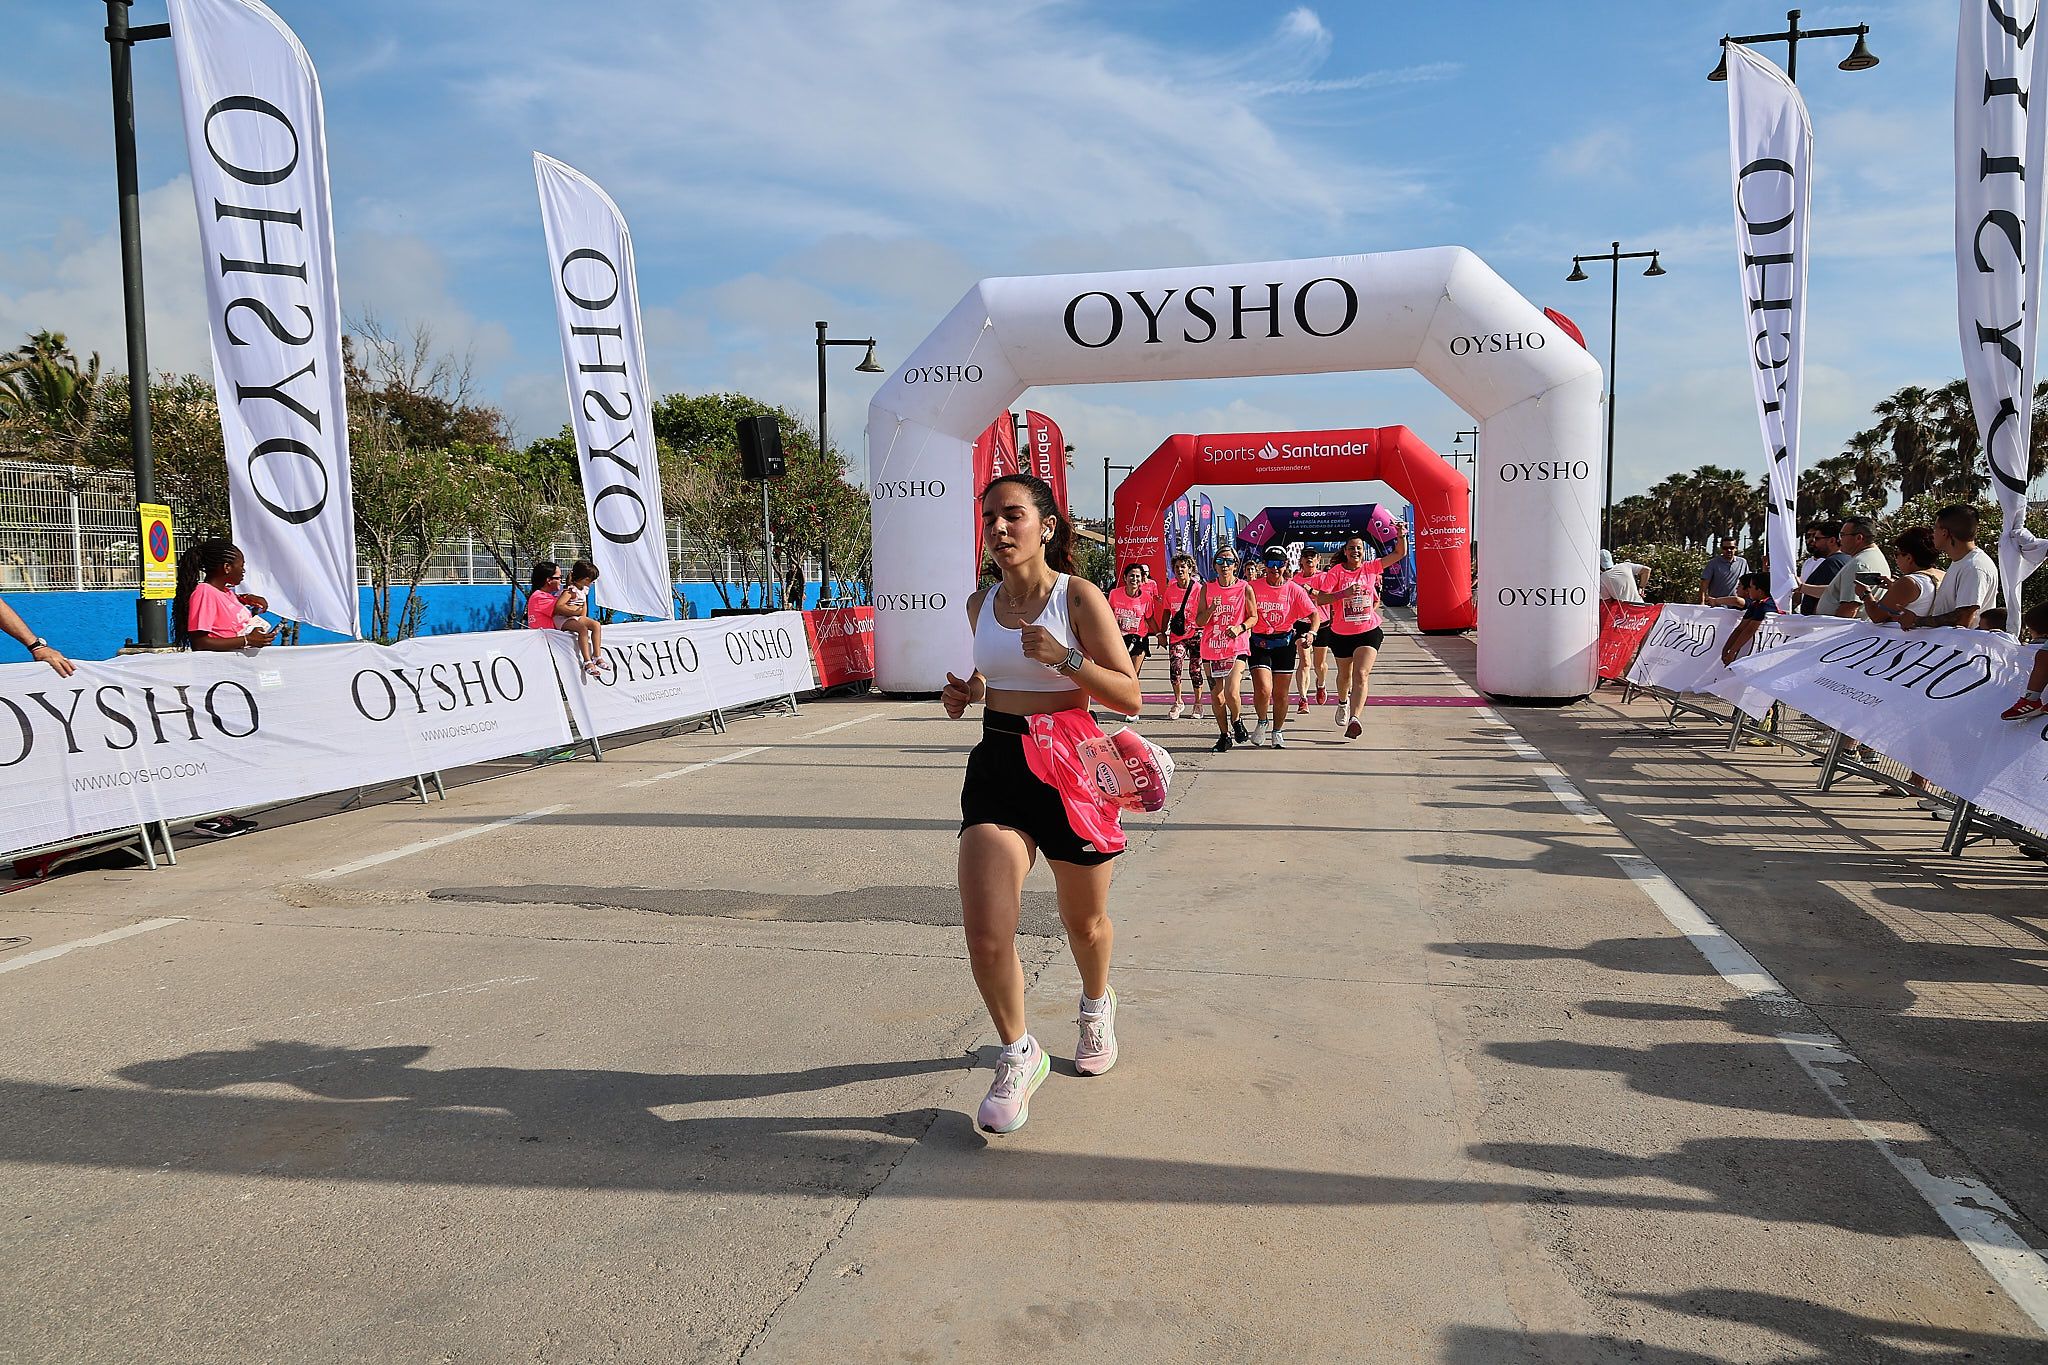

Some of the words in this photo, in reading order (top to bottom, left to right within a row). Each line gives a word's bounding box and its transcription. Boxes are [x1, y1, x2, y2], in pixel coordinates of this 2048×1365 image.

[1063, 277, 1359, 349] OYSHO
[1449, 332, 1545, 356] OYSHO
[904, 364, 983, 385] OYSHO
[1203, 446, 1255, 464] Sports
[1281, 441, 1368, 459] Santander
[1499, 460, 1589, 483] OYSHO
[874, 480, 946, 500] OYSHO
[1125, 524, 1148, 532] Sports
[1431, 514, 1456, 523] Sports
[1124, 536, 1159, 544] Santander
[1430, 526, 1466, 535] Santander
[876, 592, 947, 612] OYSHO
[1498, 586, 1586, 607] OYSHO
[816, 619, 845, 642] Sports
[725, 627, 793, 667] OYSHO
[598, 636, 699, 687] OYSHO
[1819, 636, 1993, 700] OYSHO
[352, 656, 524, 722] OYSHO
[421, 720, 499, 741] WWW.OYSHO.COM
[72, 762, 208, 792] WWW.OYSHO.COM
[1125, 757, 1149, 788] 016
